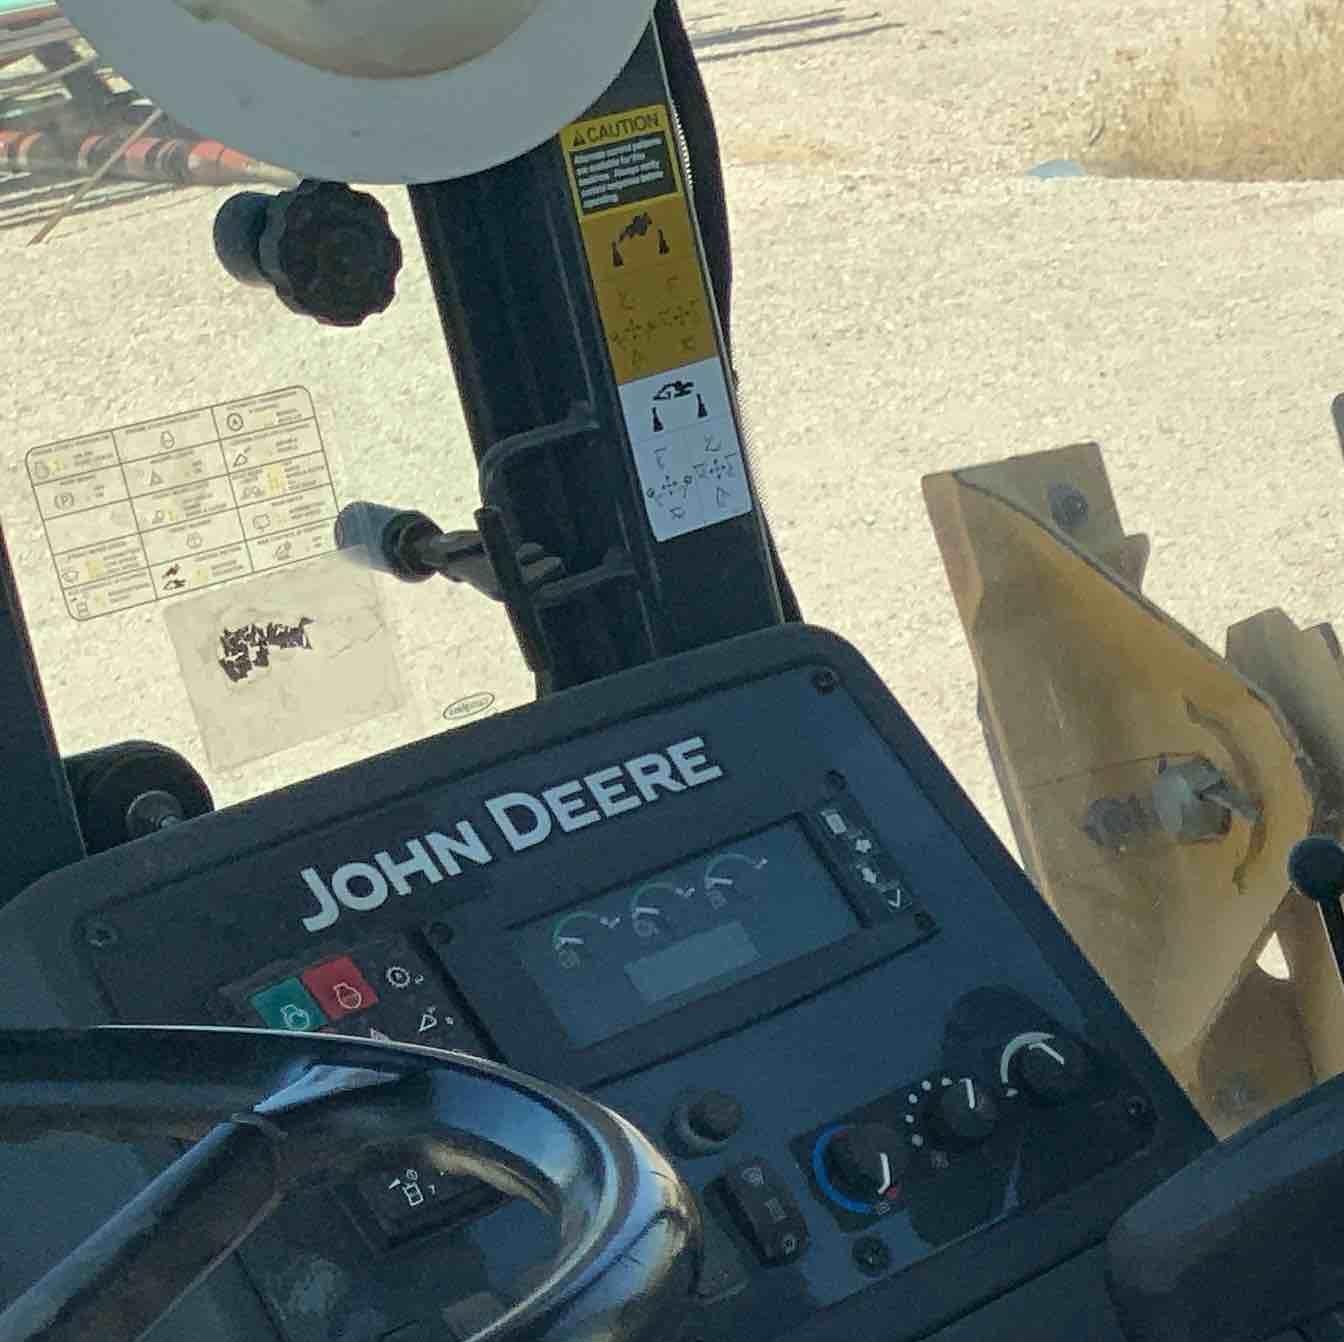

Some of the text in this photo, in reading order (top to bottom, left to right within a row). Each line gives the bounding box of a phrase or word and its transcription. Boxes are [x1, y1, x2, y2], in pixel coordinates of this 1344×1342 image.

[587, 113, 659, 140] CAUTION
[301, 736, 723, 932] JOHN DEERE
